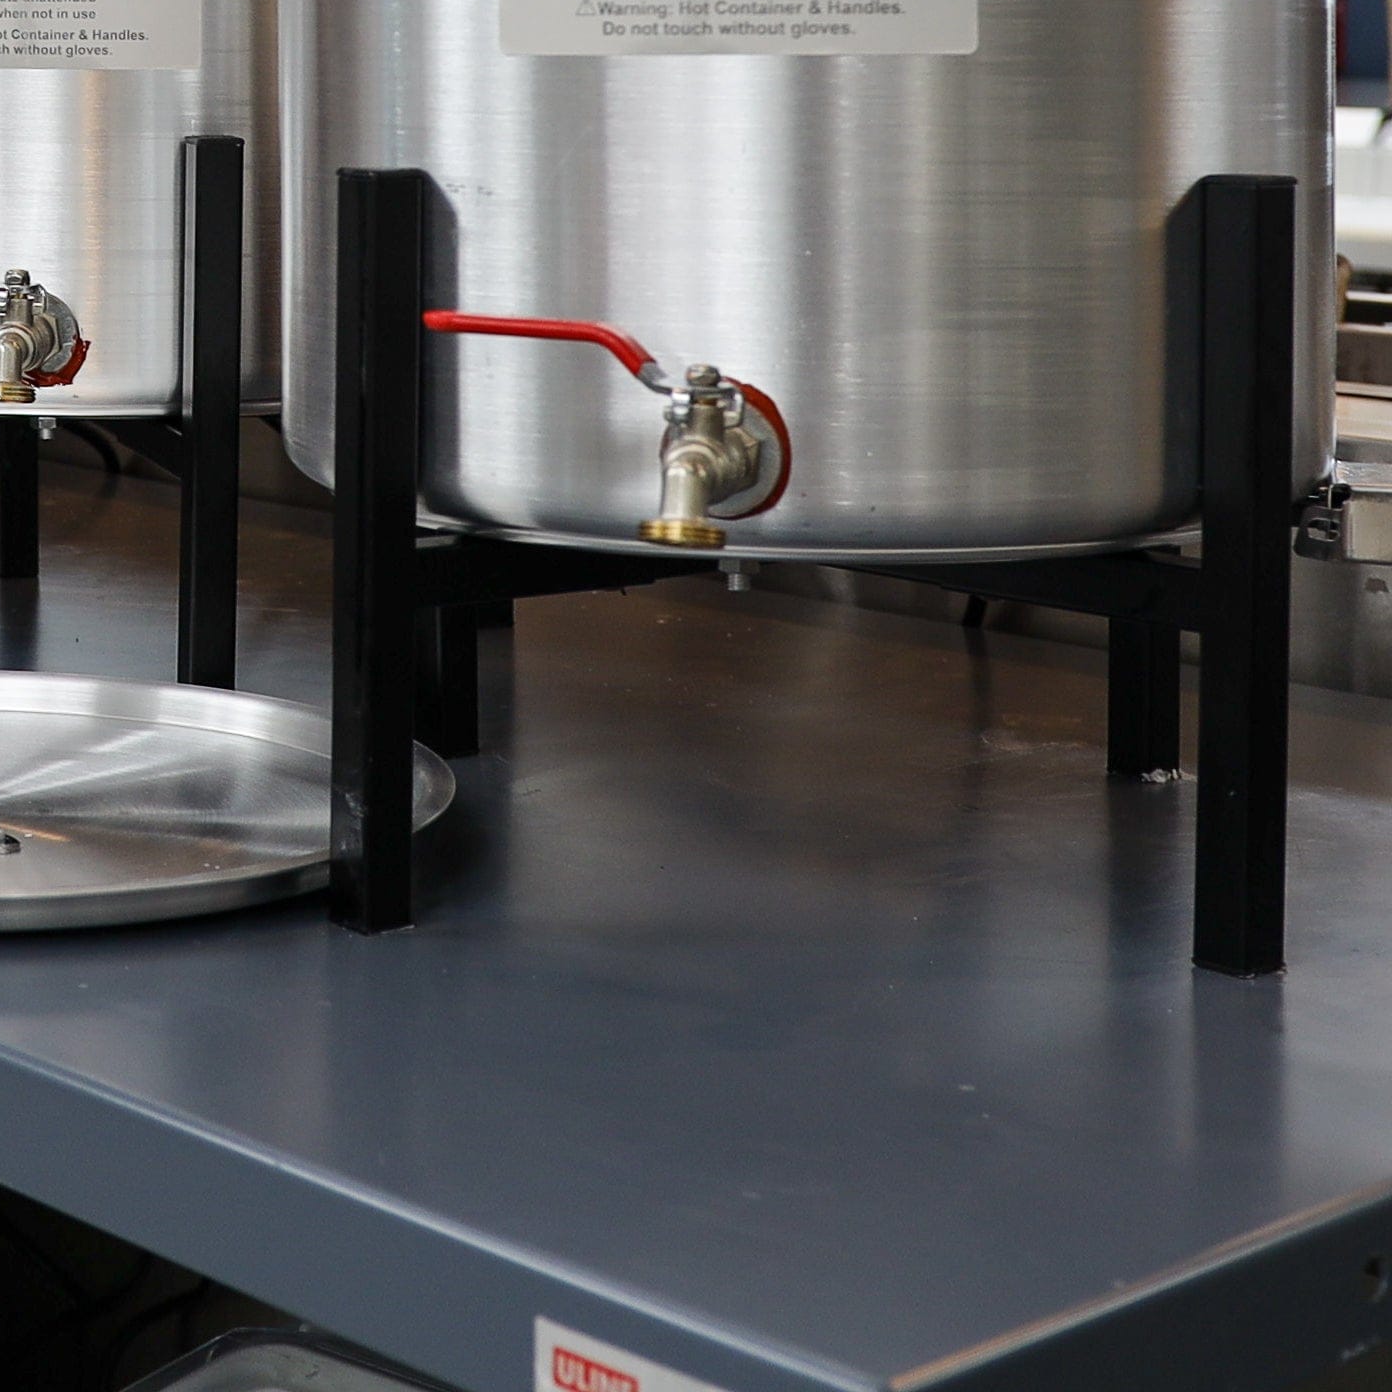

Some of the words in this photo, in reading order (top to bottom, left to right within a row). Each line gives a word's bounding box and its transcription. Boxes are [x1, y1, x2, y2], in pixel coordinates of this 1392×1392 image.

[30, 8, 53, 19] not
[56, 10, 69, 18] in
[72, 10, 96, 19] use
[678, 1, 710, 15] Hot
[714, 0, 803, 15] Container
[807, 0, 822, 14] &
[10, 28, 75, 40] Container
[78, 28, 88, 40] &
[91, 29, 149, 40] Handles.
[601, 20, 626, 36] Do
[630, 22, 659, 36] not
[662, 21, 713, 36] touch
[718, 21, 786, 35] without
[12, 43, 62, 55] without
[64, 44, 112, 58] gloves.
